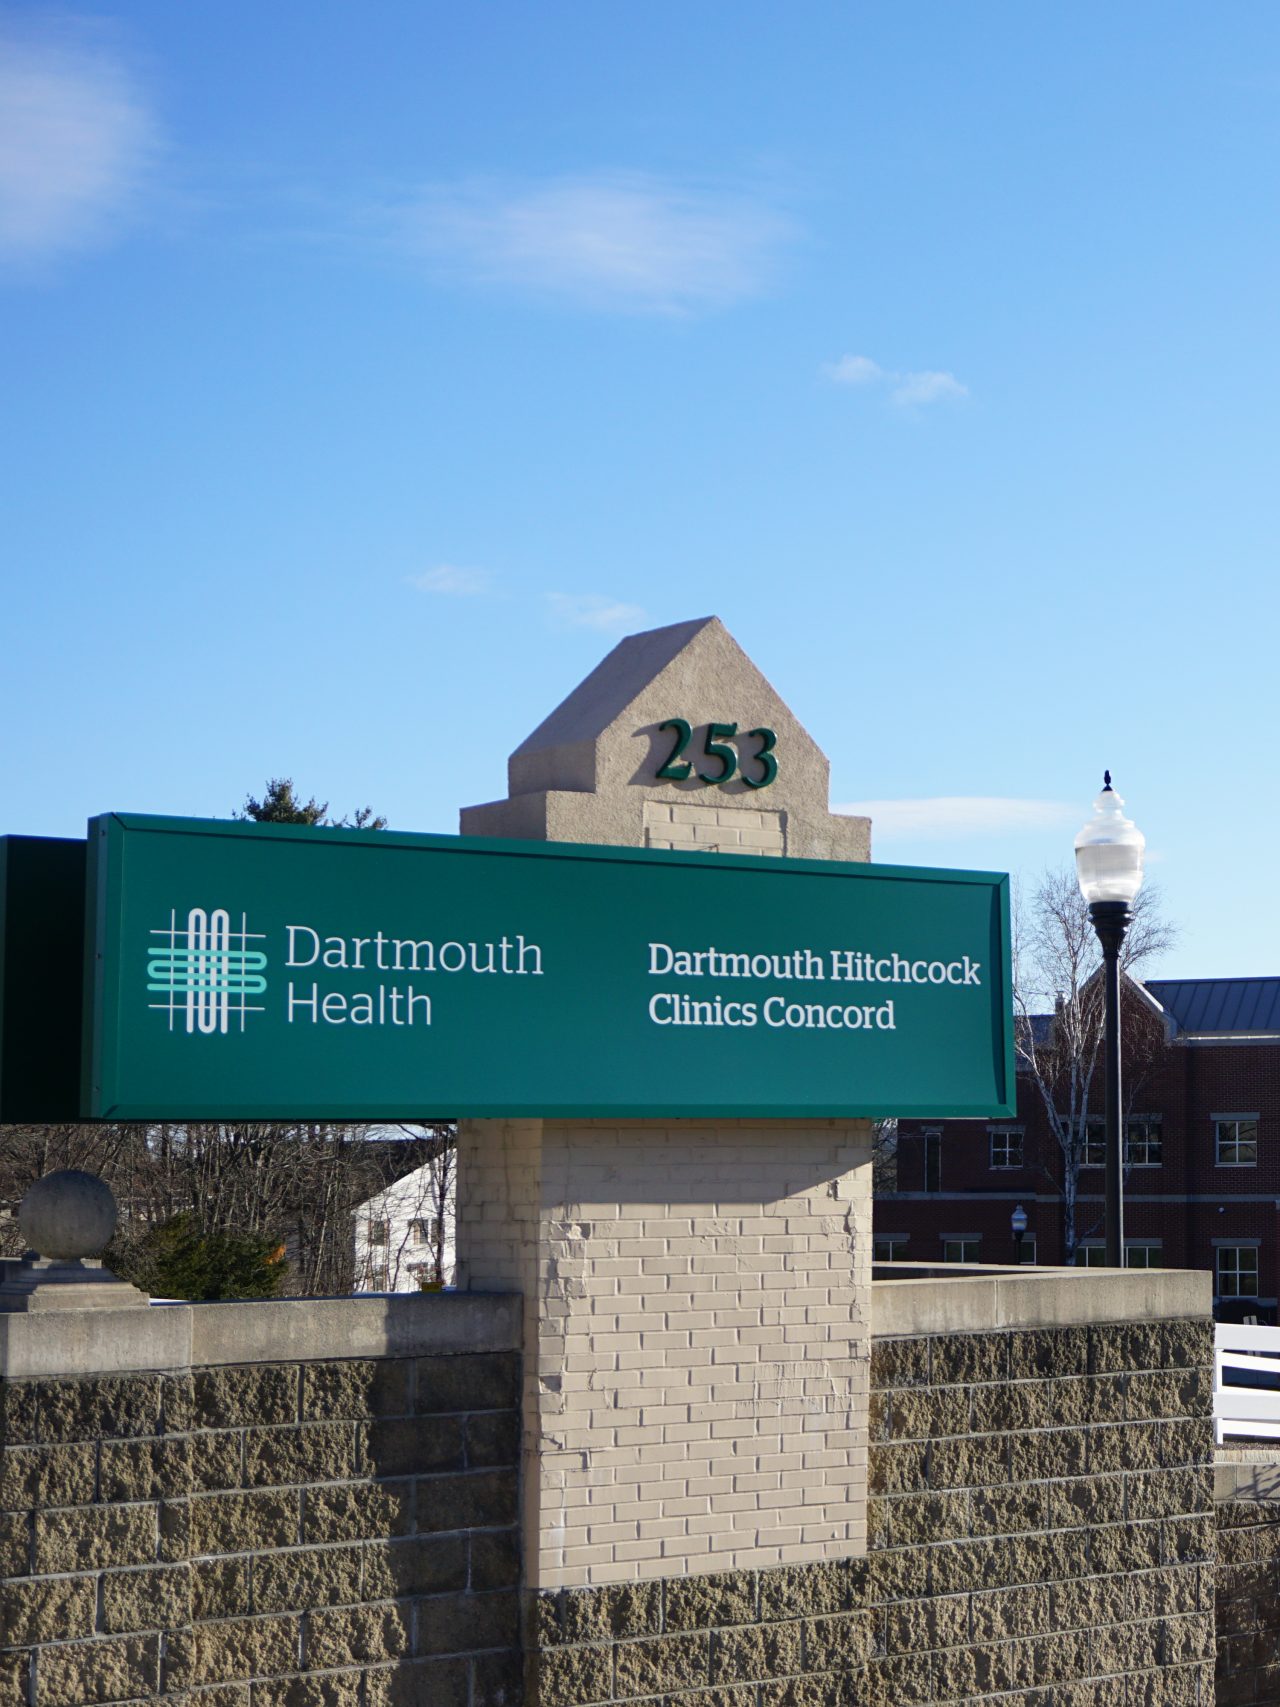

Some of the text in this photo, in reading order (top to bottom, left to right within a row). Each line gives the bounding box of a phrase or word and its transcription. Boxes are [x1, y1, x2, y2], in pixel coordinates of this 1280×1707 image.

[655, 718, 779, 789] 253
[286, 925, 544, 975] Dartmouth
[648, 944, 981, 985] Dartmouth Hitchcock
[289, 982, 431, 1025] Health
[648, 994, 897, 1030] Clinics Concord
